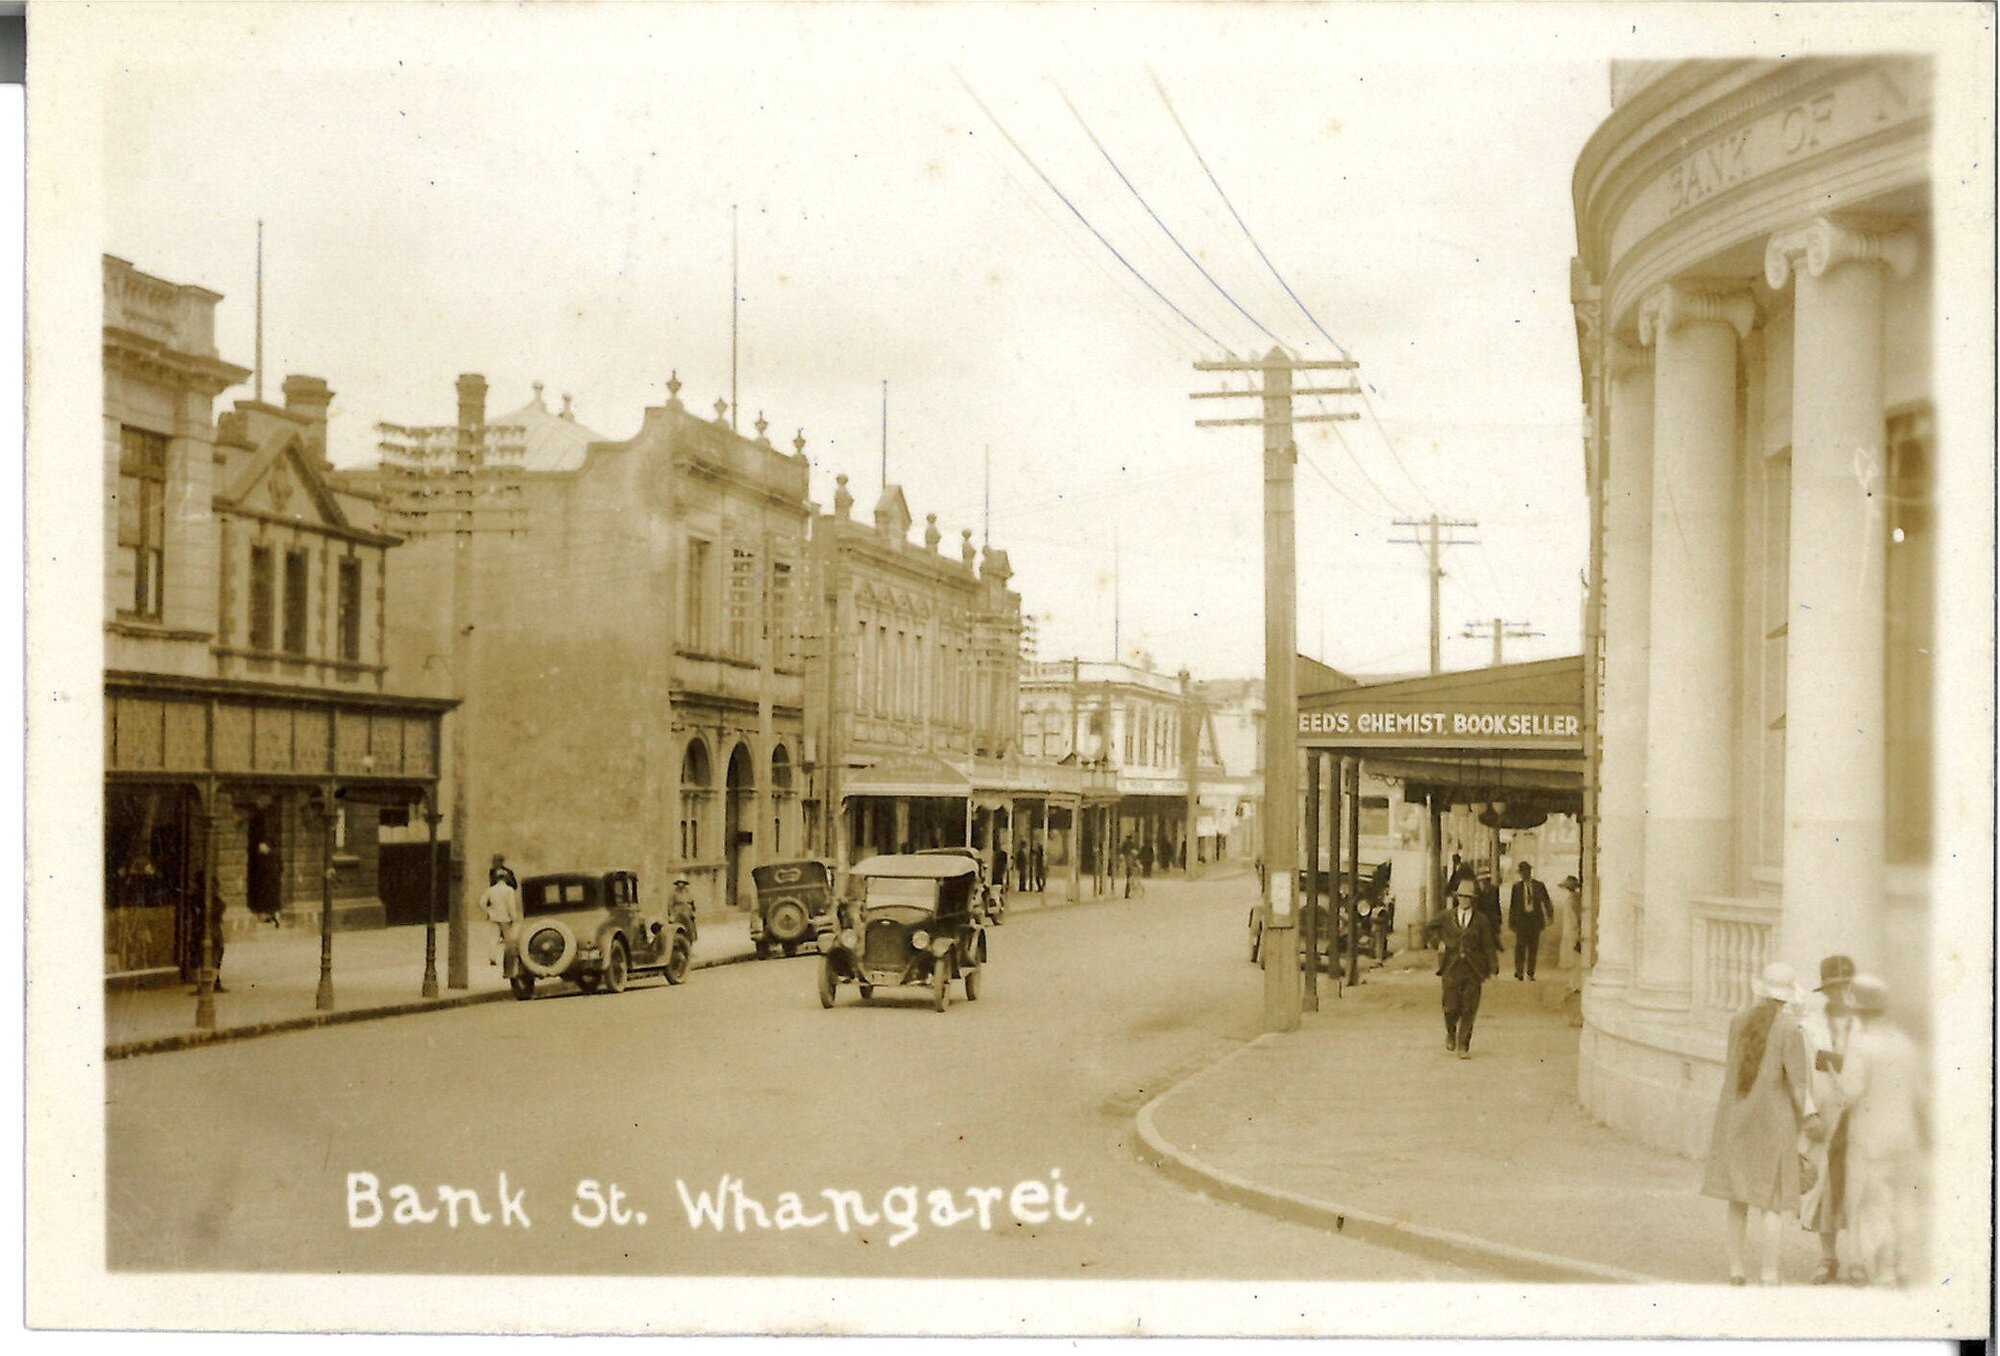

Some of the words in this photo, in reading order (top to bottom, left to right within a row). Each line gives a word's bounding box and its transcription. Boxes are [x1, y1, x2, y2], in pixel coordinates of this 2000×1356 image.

[1781, 91, 1836, 155] OF
[1298, 712, 1354, 734] EED'S.
[1453, 713, 1580, 735] BOOKSELLER
